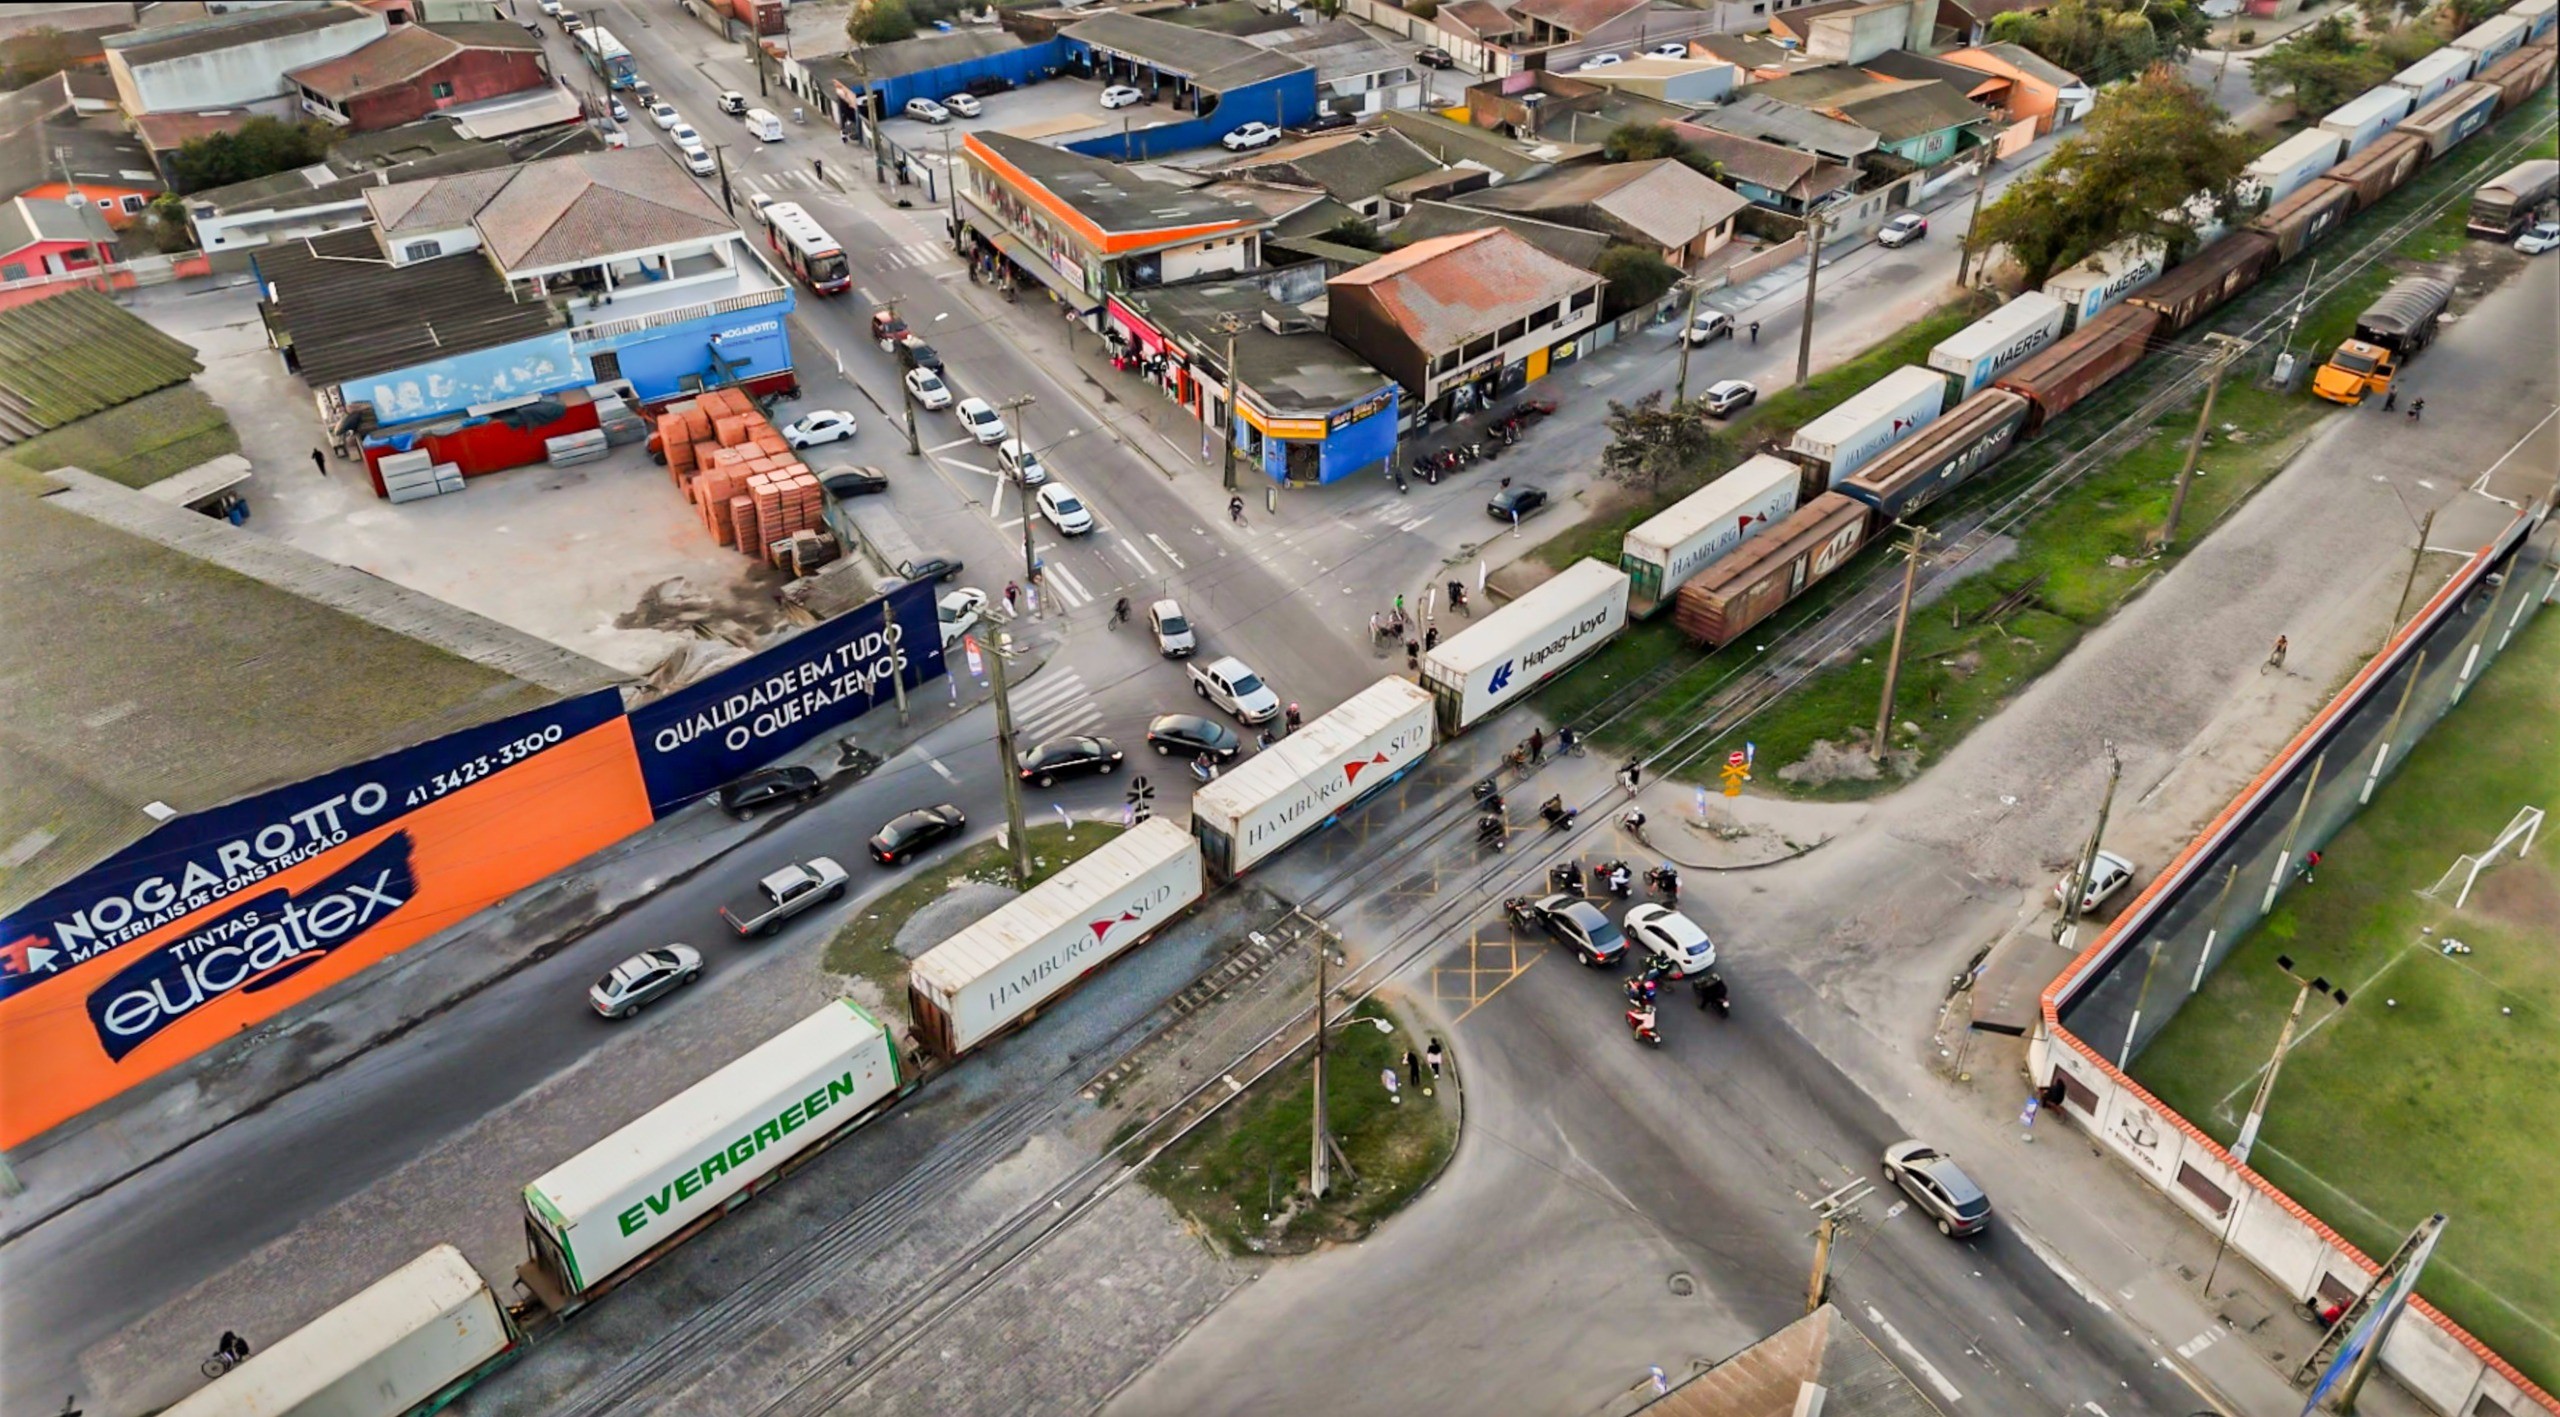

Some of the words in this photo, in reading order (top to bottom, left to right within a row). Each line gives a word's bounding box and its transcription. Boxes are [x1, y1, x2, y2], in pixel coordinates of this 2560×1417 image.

[2102, 259, 2154, 302] MAERSK
[721, 321, 778, 339] NOGAROTTO
[1992, 322, 2052, 373] MAERSK
[1671, 526, 1738, 577] HAMBURG
[1769, 491, 1792, 516] SÜD
[1818, 530, 1854, 569] ALL
[1522, 606, 1608, 672] Hapag-Lloyd
[655, 670, 798, 752] QUALIDADE
[800, 653, 834, 686] EM
[836, 624, 902, 667] TUDO
[725, 726, 751, 751] O
[753, 698, 802, 738] QUE
[802, 649, 908, 717] FAZEMOS
[405, 785, 428, 806] 41
[431, 724, 563, 796] 3423-3300
[1248, 774, 1344, 847] HAMBURG
[1390, 724, 1424, 756] SÜD
[54, 782, 388, 951] NOGAROTTO
[70, 901, 187, 964] MATERIAIS
[190, 889, 211, 911] DE
[212, 829, 349, 899] CONSTRUÇÃO
[104, 868, 404, 1036] eucatex
[168, 910, 261, 962] TINTAS
[989, 933, 1094, 1011] HAMBURG
[1131, 885, 1170, 917] SÜD
[618, 1071, 855, 1238] EVERGREEN
